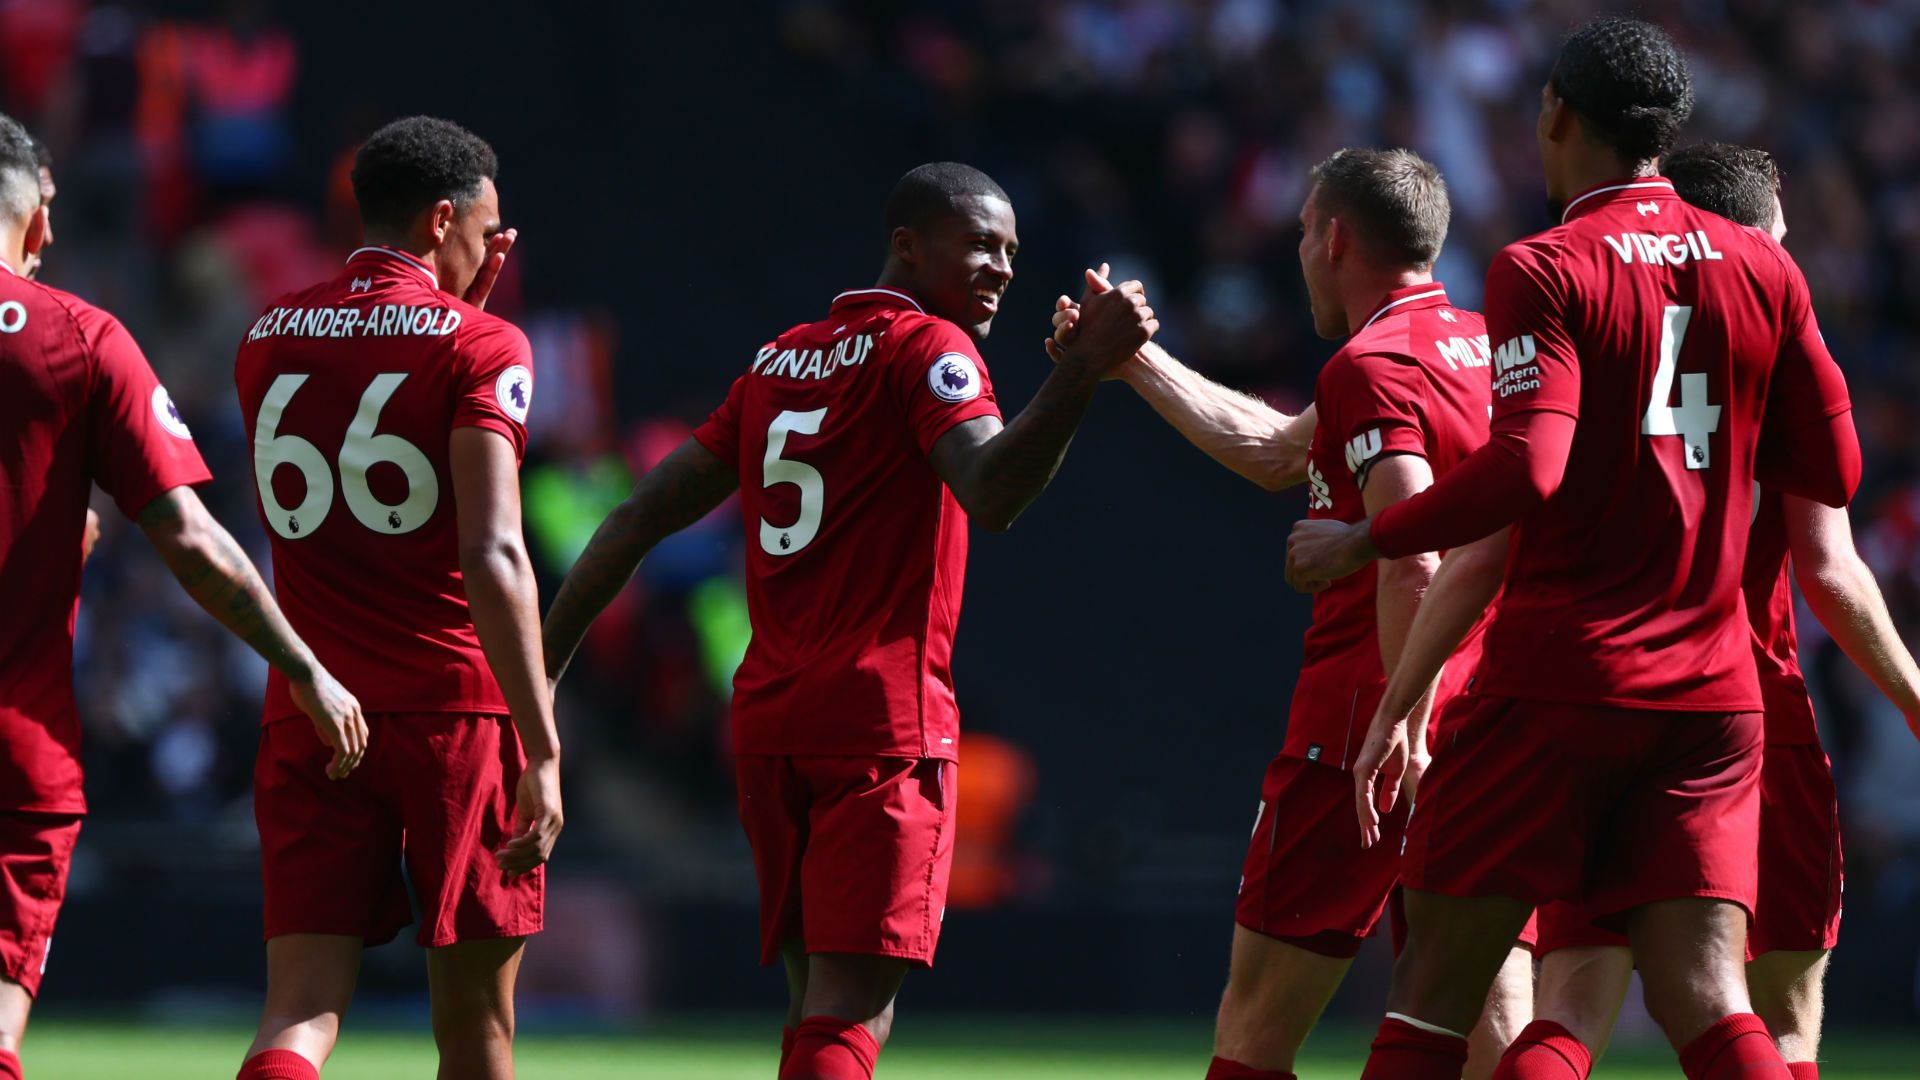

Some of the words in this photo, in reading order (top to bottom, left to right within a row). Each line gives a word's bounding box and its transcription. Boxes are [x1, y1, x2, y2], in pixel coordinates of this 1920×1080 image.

[1603, 229, 1724, 267] VIRGIL
[246, 304, 463, 344] ALEXANDER-ARNOLD
[1500, 379, 1541, 398] Union
[1640, 304, 1723, 470] 4
[254, 373, 439, 539] 66
[759, 405, 828, 557] 5
